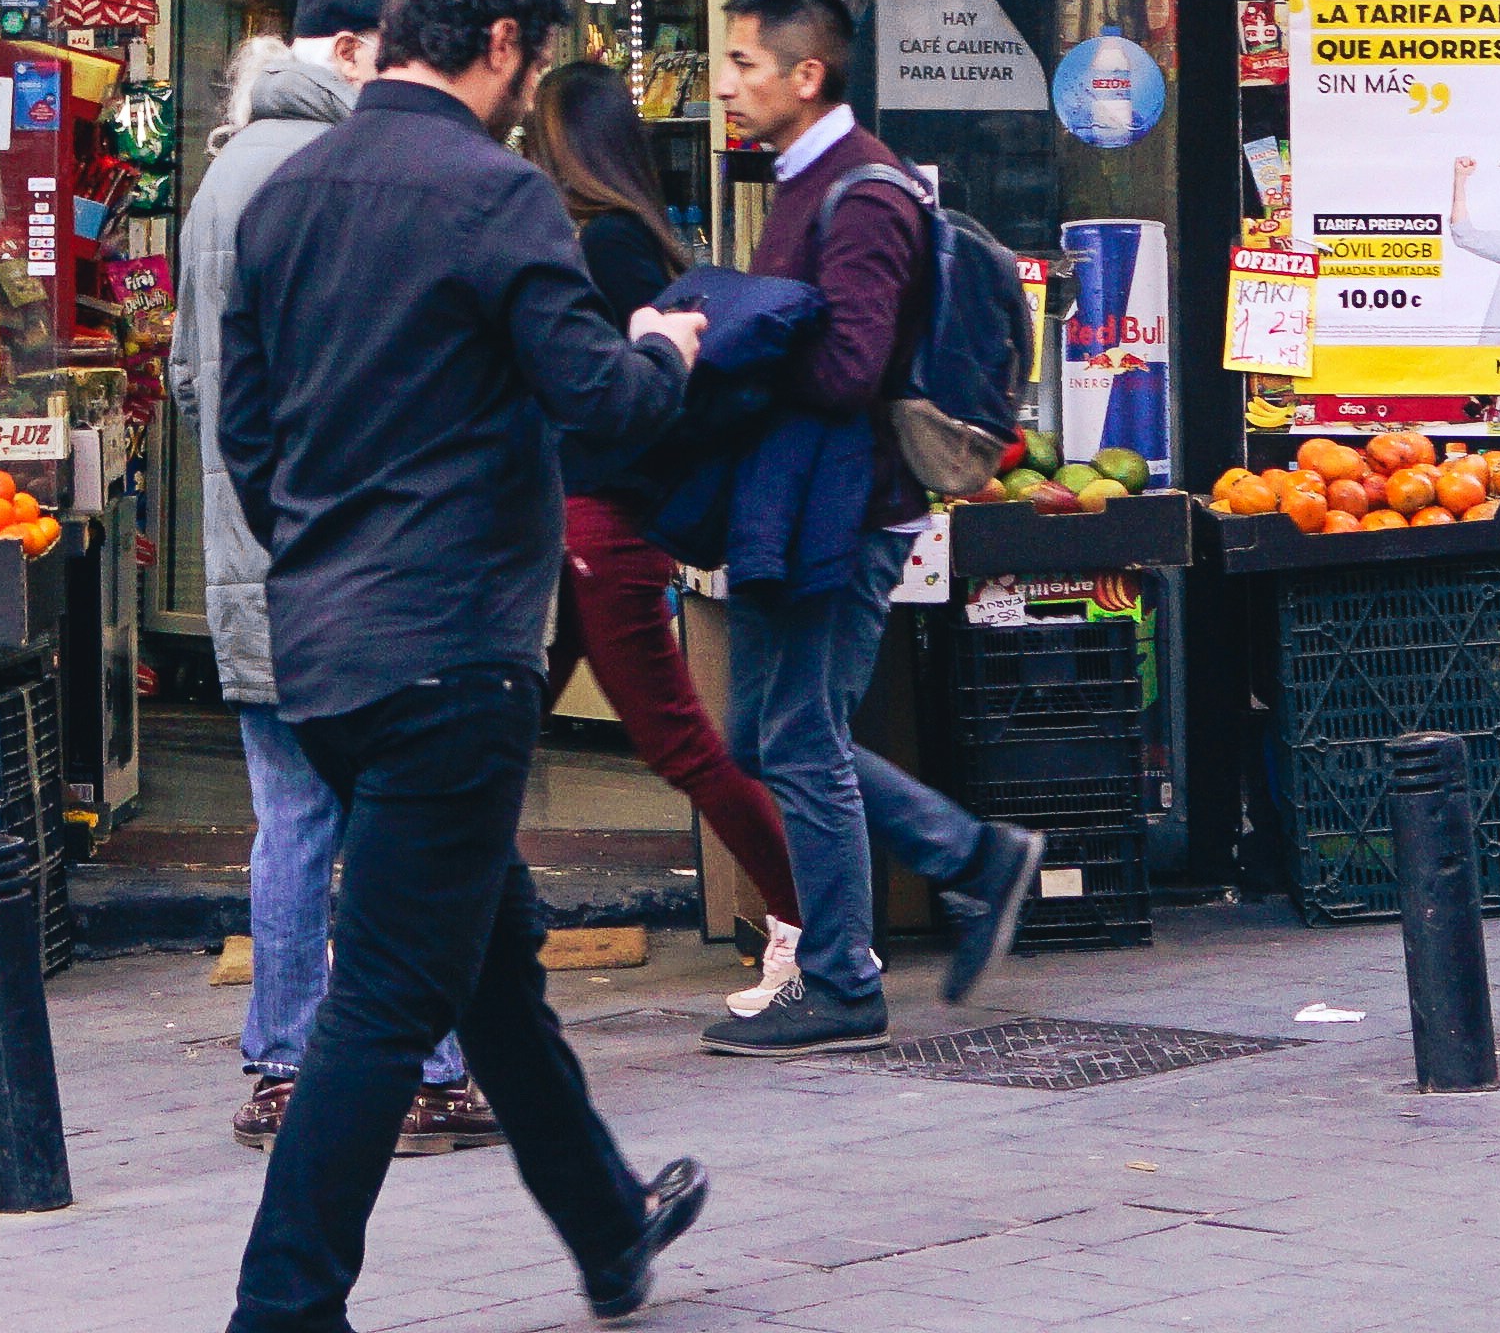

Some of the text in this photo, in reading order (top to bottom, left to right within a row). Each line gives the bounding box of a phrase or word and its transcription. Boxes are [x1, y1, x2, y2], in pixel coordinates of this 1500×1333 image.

[943, 11, 977, 27] HAY
[1317, 4, 1348, 24] LA
[1355, 3, 1453, 24] TARIFA
[900, 37, 1023, 56] CAFÉ CALIENTE
[1317, 39, 1372, 62] QUE
[900, 65, 1013, 81] PARA LLEVAR
[1317, 67, 1416, 94] SIN MÁS
[1316, 217, 1440, 232] TARIFA PREPAGO
[1380, 240, 1433, 260] 20GB
[1234, 248, 1315, 277] OFERTA
[1238, 279, 1296, 305] KAKI
[1066, 315, 1167, 346] Red Bull
